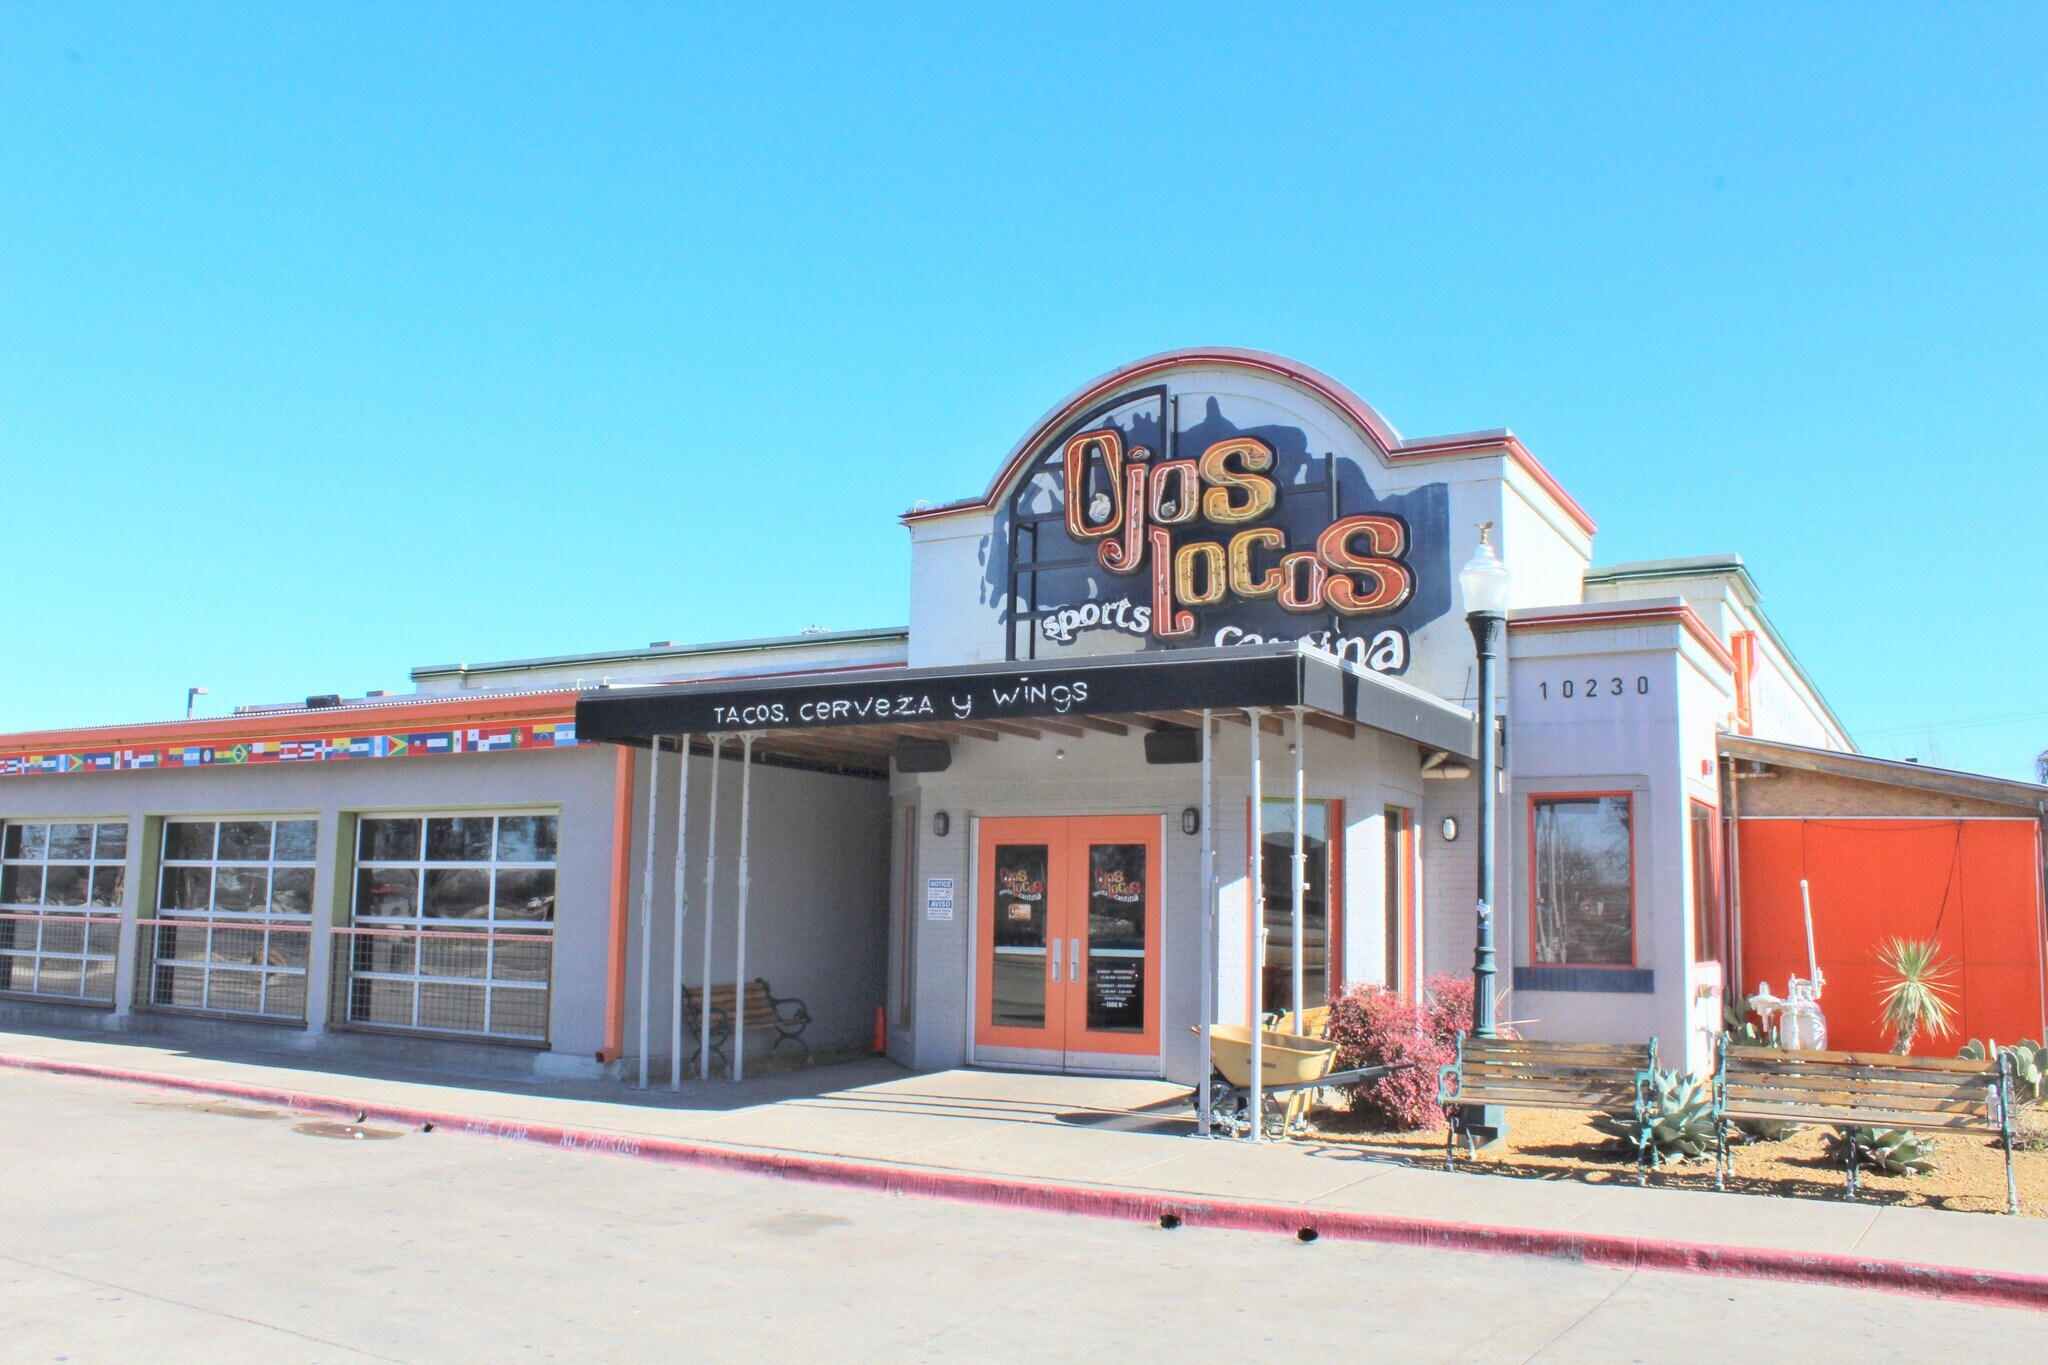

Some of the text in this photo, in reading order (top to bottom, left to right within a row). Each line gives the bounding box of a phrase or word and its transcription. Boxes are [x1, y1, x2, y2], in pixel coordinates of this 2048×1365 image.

[1043, 598, 1151, 640] sports
[1540, 676, 1648, 700] 10230
[930, 880, 952, 888] NOTICE
[930, 900, 951, 908] AVISO
